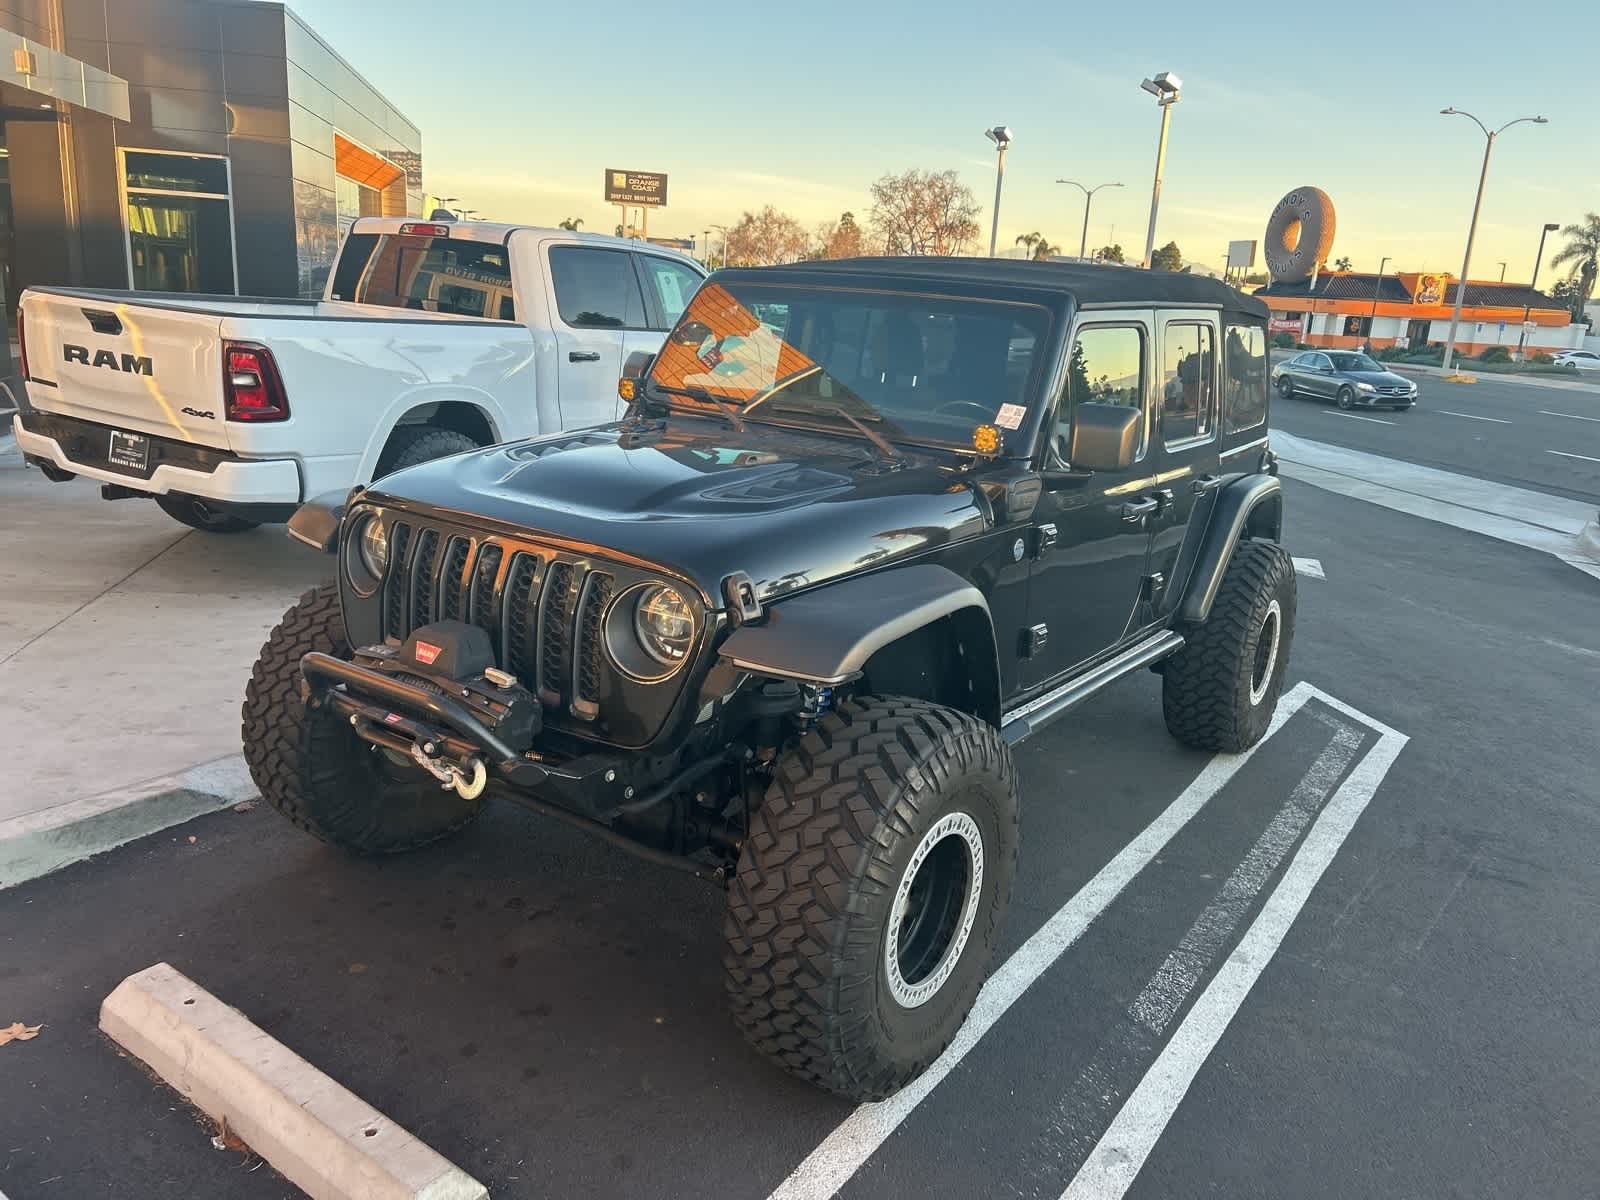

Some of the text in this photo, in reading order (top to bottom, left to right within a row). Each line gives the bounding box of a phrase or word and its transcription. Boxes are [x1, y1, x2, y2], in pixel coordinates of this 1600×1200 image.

[628, 179, 660, 187] ORANGE
[632, 184, 657, 192] COAST
[63, 343, 153, 377] RAM
